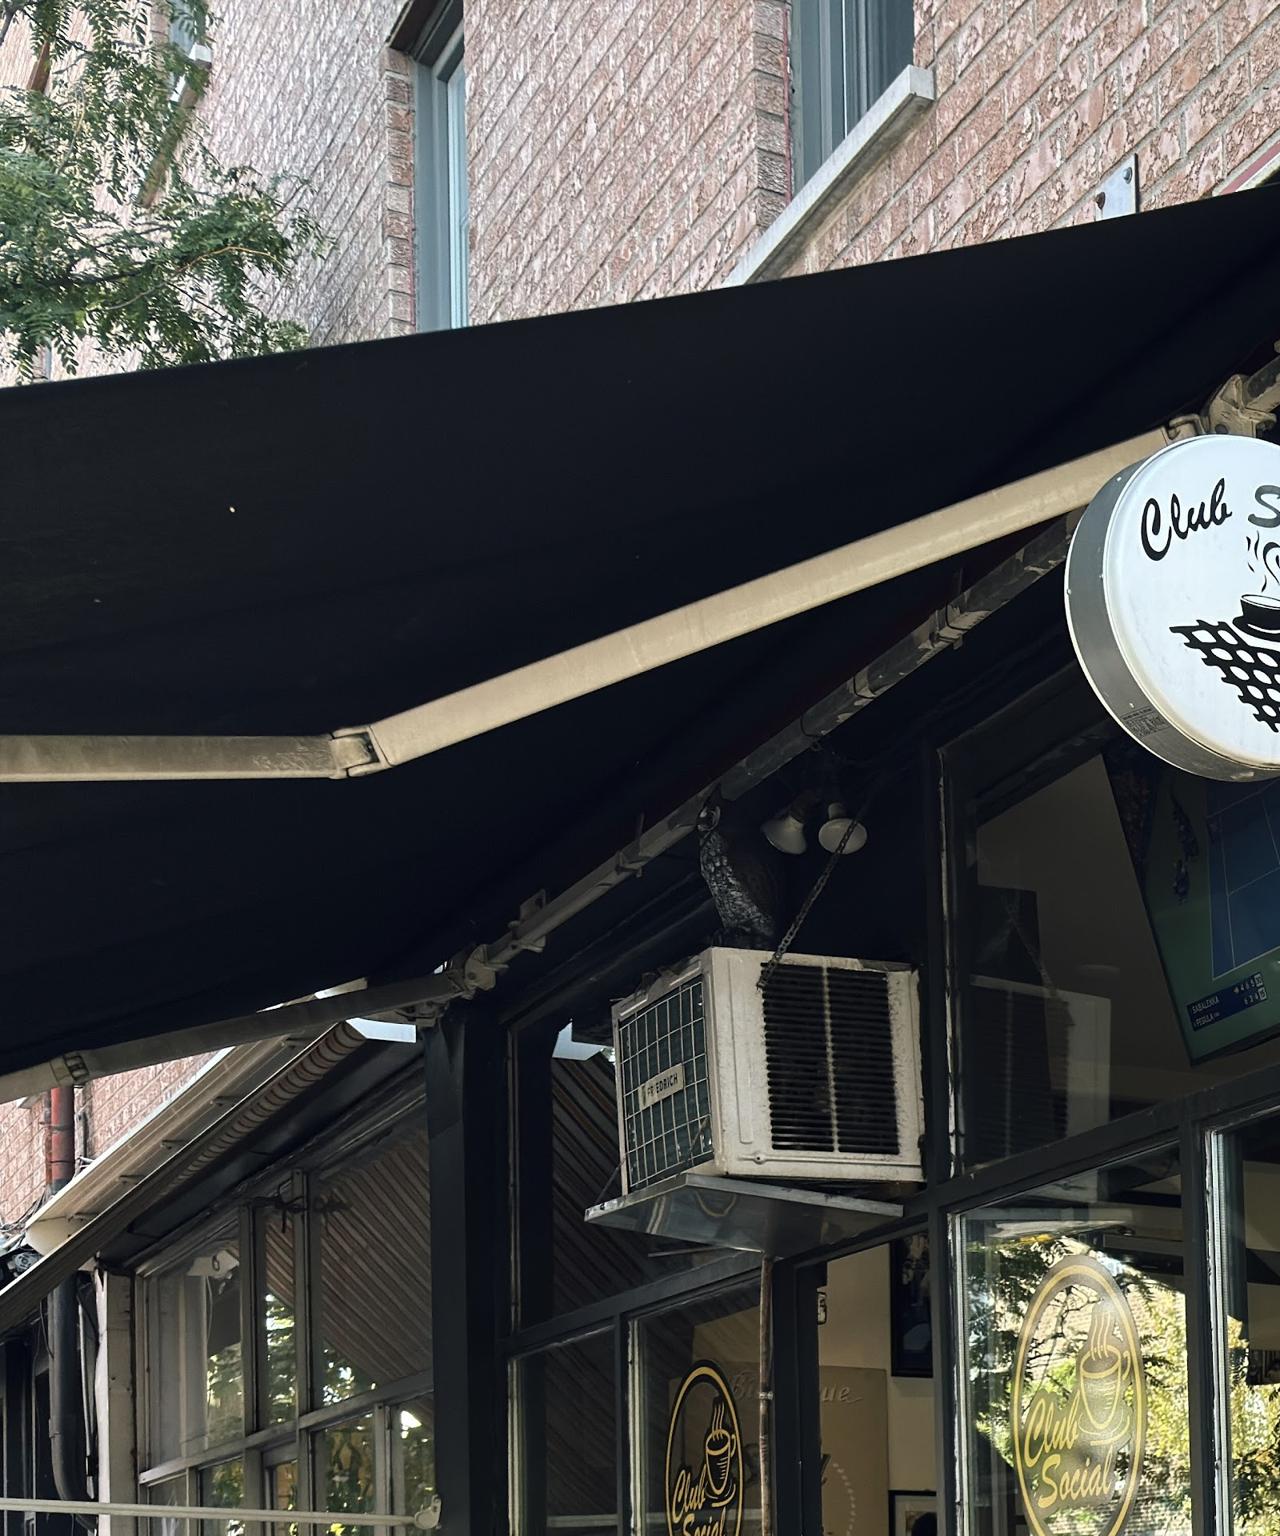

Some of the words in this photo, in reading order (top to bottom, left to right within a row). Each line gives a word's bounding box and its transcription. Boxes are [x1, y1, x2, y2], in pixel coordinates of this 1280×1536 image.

[1140, 478, 1232, 561] Club
[647, 1074, 678, 1095] FREDRICH
[1024, 1389, 1082, 1468] Club
[672, 1464, 707, 1524] Club
[1038, 1446, 1113, 1509] Social
